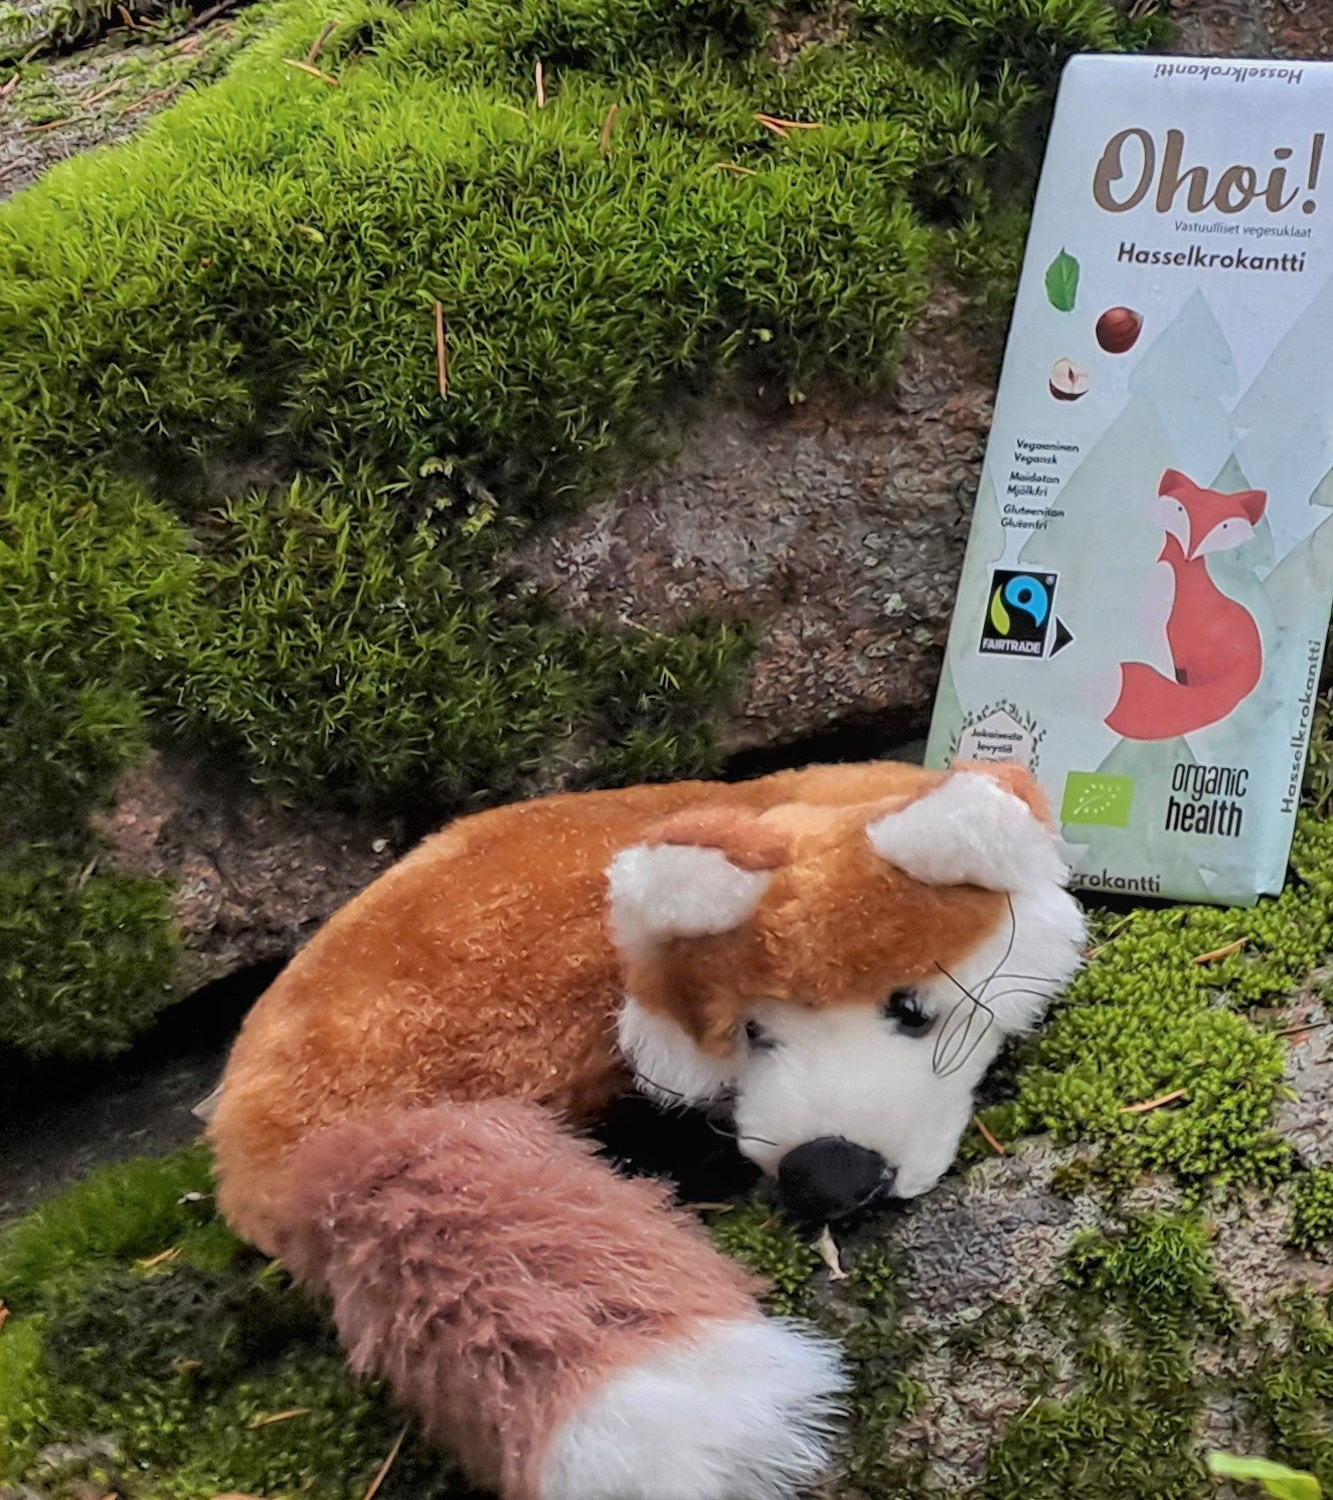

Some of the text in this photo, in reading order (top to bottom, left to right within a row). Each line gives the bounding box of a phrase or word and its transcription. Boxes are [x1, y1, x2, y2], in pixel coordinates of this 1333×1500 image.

[1153, 63, 1304, 85] Hasselkrokantti
[1092, 127, 1326, 215] Ohoi!
[1174, 221, 1312, 240] Vastuulliset vegesuklaat
[1117, 241, 1306, 273] Hasselkrokantti
[982, 637, 1042, 654] FAIRTRADE
[1280, 640, 1322, 814] Hasselkrokantti
[1171, 763, 1249, 802] organic
[1165, 796, 1244, 838] health
